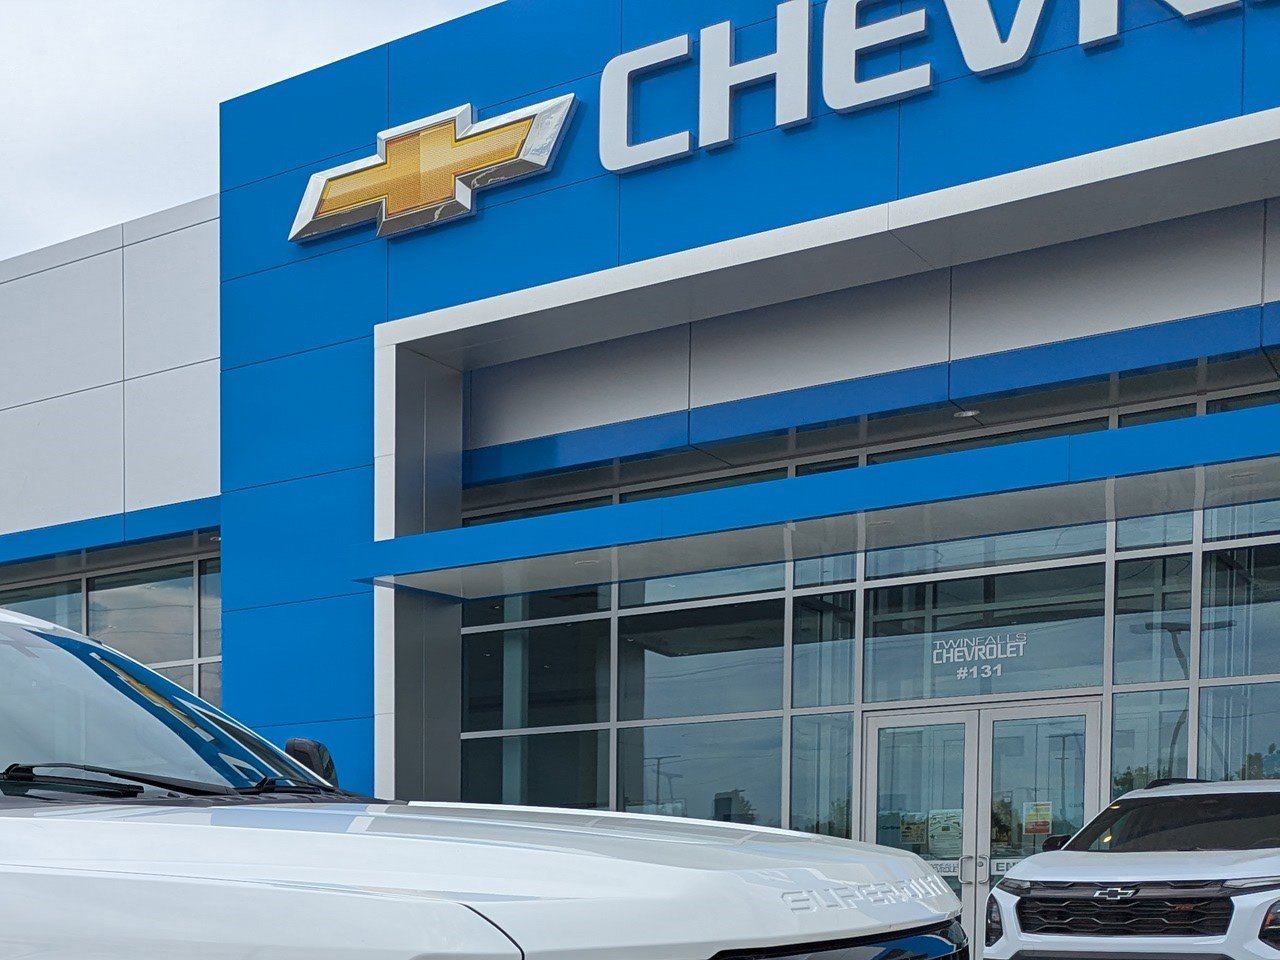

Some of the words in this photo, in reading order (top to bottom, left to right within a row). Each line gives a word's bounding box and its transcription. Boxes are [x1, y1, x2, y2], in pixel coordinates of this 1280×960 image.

[932, 632, 1027, 649] TWINFALLS
[932, 641, 1027, 664] CHEVROLET
[956, 663, 1002, 680] #131
